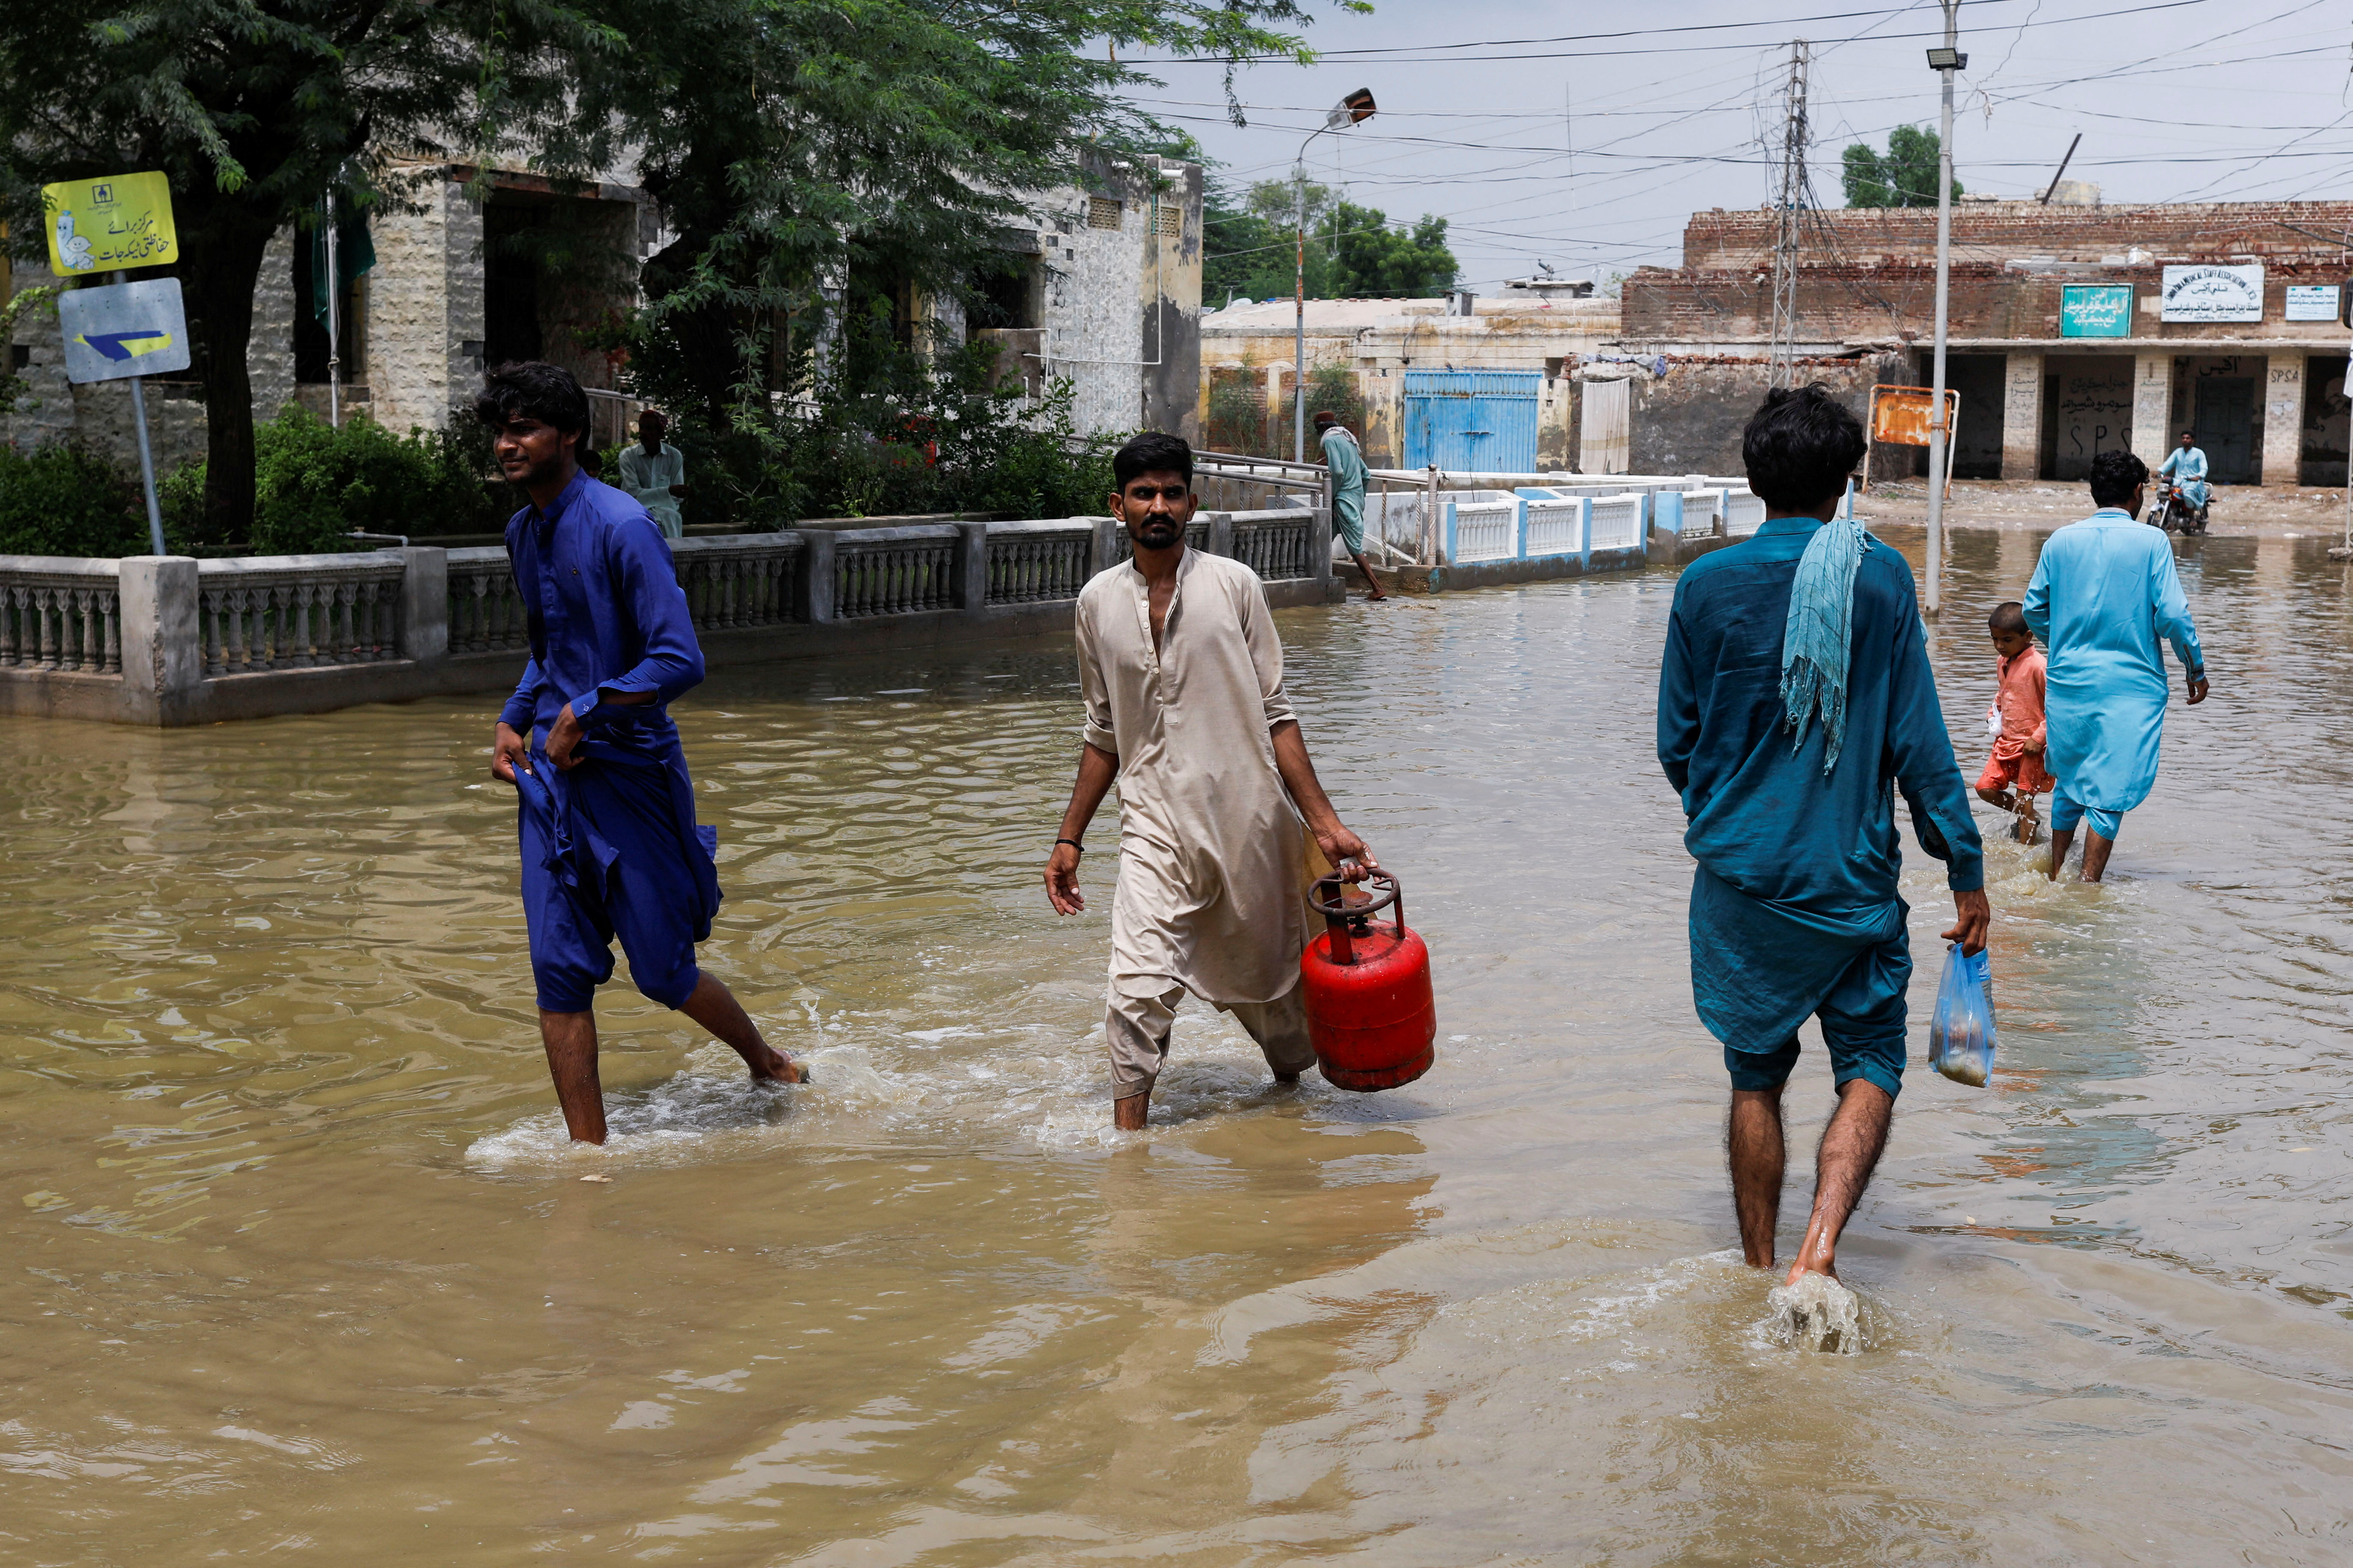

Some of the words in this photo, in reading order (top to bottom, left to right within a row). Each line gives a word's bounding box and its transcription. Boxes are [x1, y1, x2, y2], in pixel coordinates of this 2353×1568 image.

[108, 221, 137, 234] برائے
[137, 210, 153, 234] مرکز
[139, 234, 169, 257] حفاظتی
[99, 246, 124, 262] جات
[2204, 269, 2217, 278] STAFF
[2272, 369, 2299, 383] SPSA
